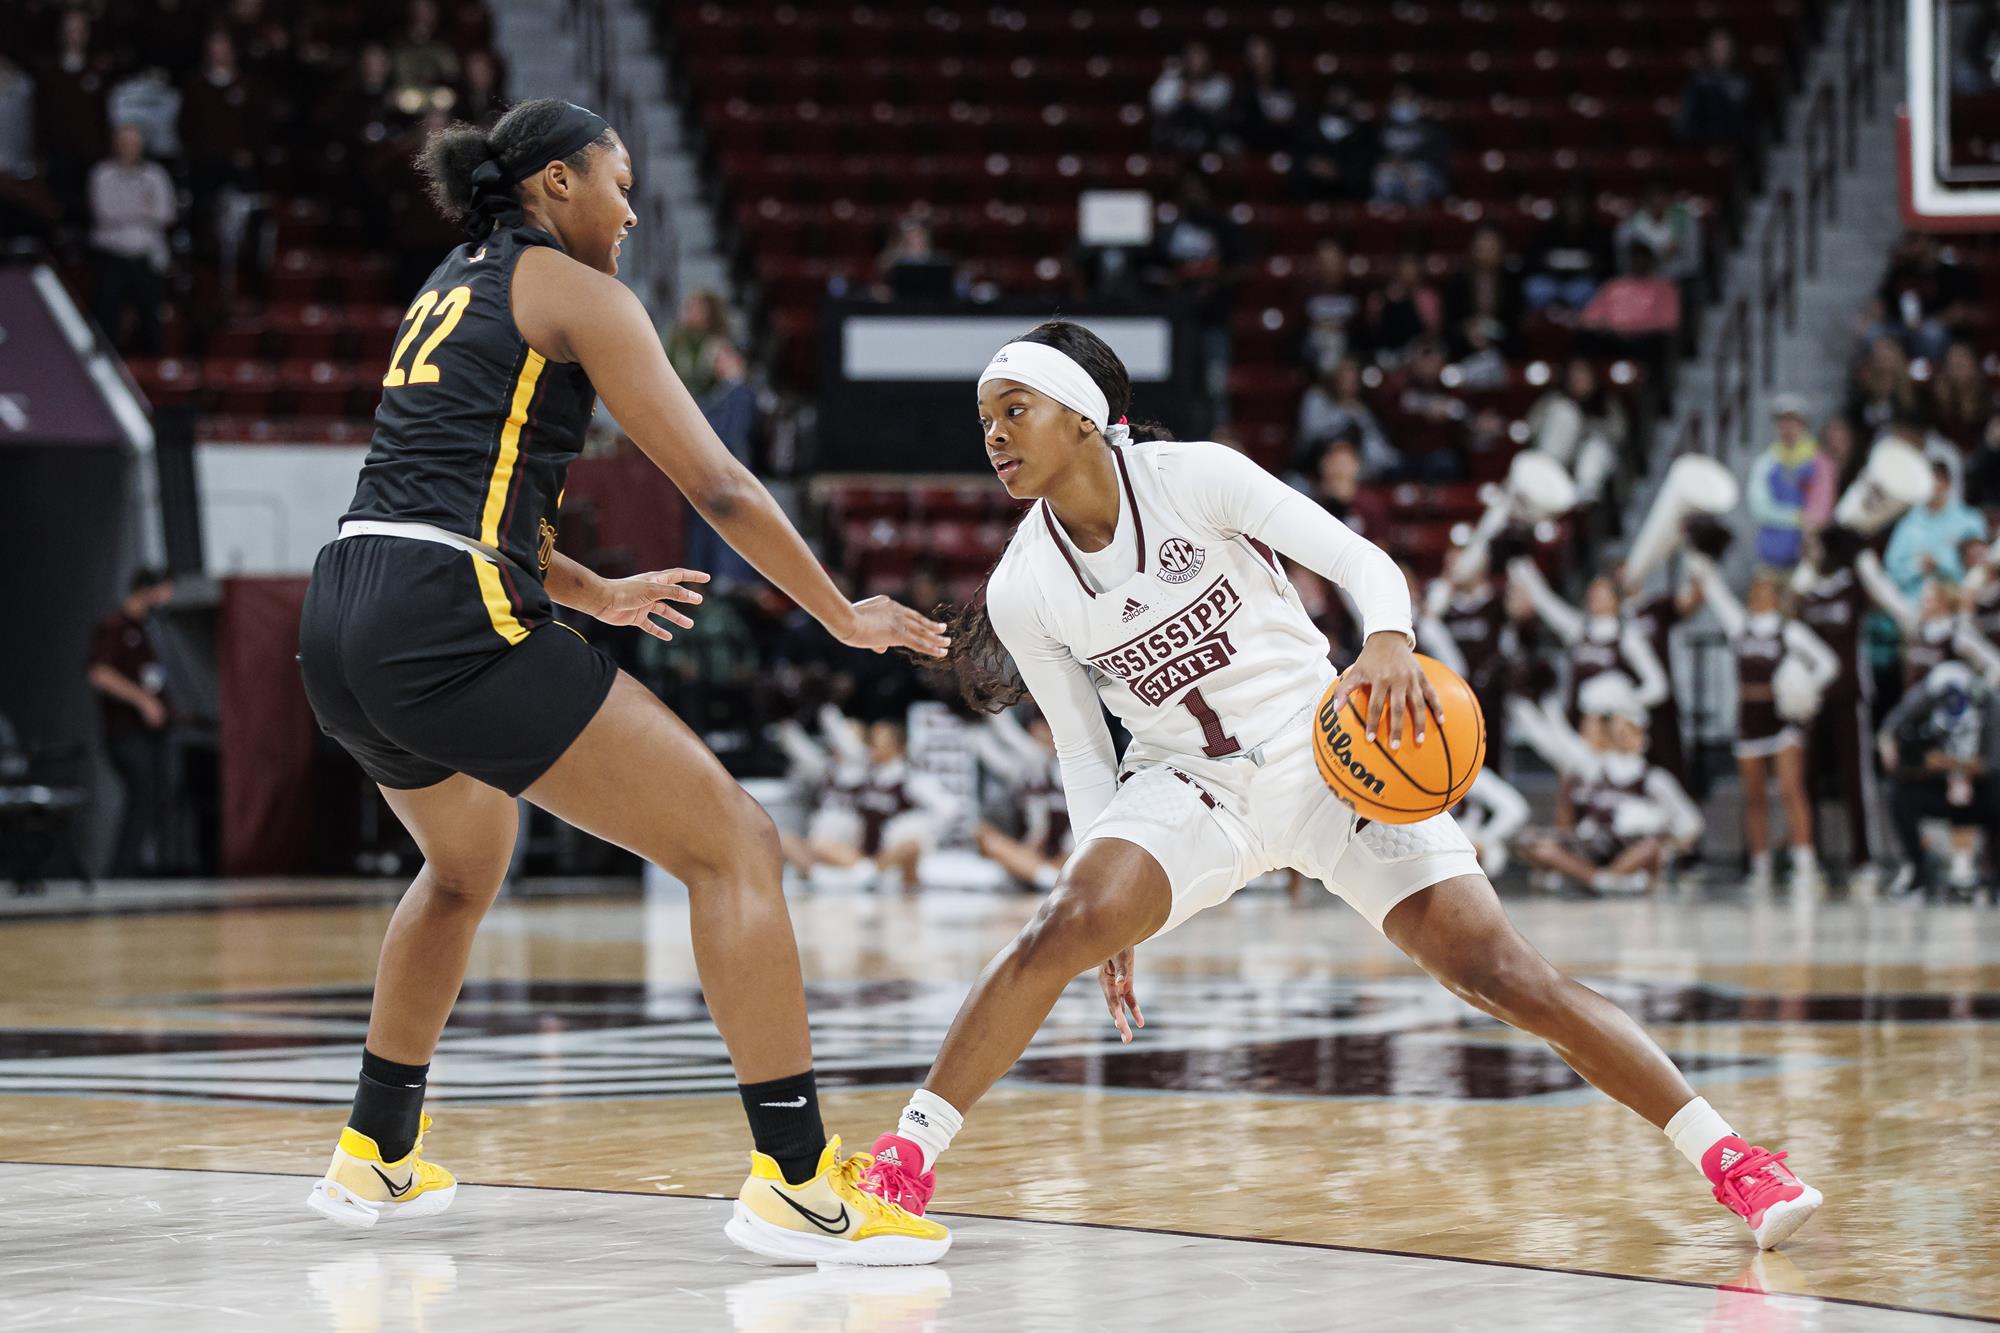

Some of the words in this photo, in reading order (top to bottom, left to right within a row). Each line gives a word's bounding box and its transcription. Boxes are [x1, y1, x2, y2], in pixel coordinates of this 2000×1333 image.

[383, 286, 471, 387] 22
[1160, 538, 1195, 572] SEC
[1166, 560, 1202, 582] GRADUATE
[1122, 604, 1150, 623] adidas
[1144, 648, 1221, 700] STATE
[1177, 685, 1242, 758] 1
[1319, 695, 1386, 795] Wilson
[876, 1155, 902, 1166] adidas
[1720, 1152, 1744, 1171] adidas
